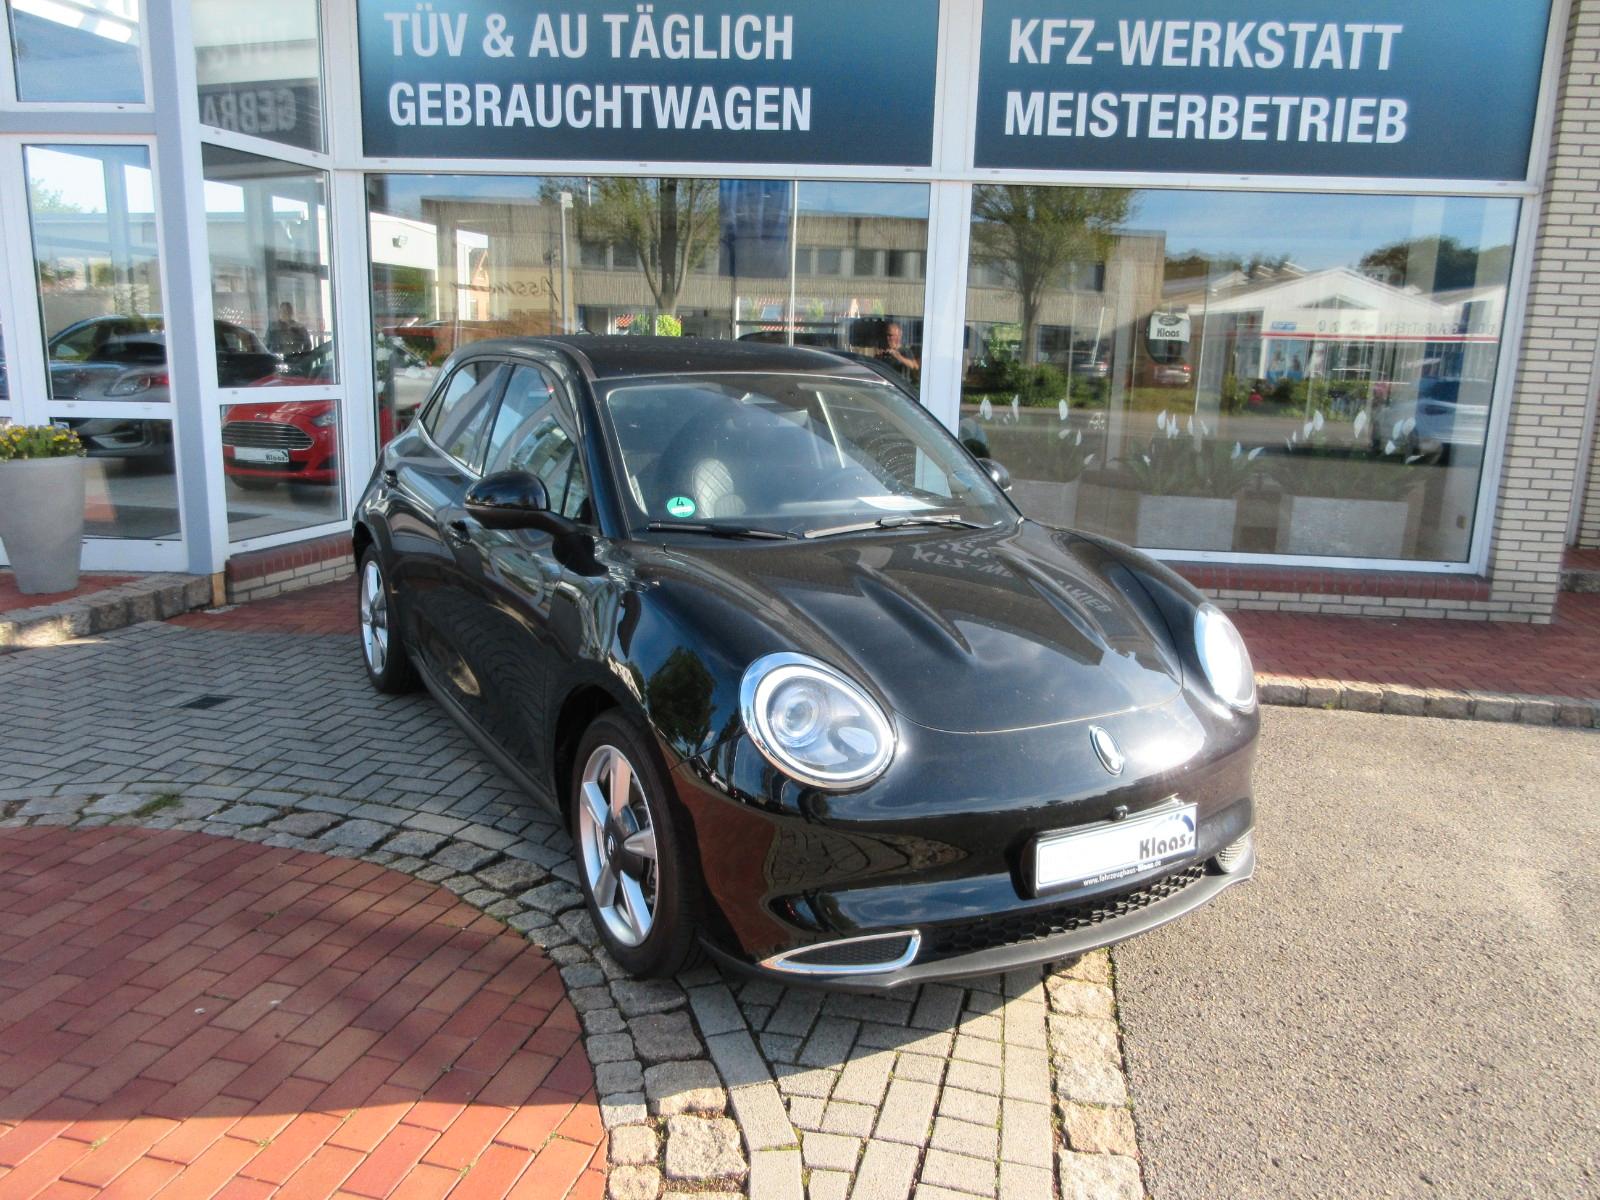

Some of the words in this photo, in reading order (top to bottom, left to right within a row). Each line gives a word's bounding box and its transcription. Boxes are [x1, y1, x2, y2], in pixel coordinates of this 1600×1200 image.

[384, 4, 468, 57] TÜV
[482, 13, 514, 58] &
[528, 12, 588, 59] AU
[603, 4, 794, 61] TÄGLICH
[1008, 18, 1403, 71] KFZ-WERKSTATT
[388, 82, 811, 131] GEBRAUCHTWAGEN
[1004, 91, 1407, 144] MEISTERBETRIEB
[1156, 328, 1180, 337] Klaas
[1139, 832, 1186, 861] Klaas
